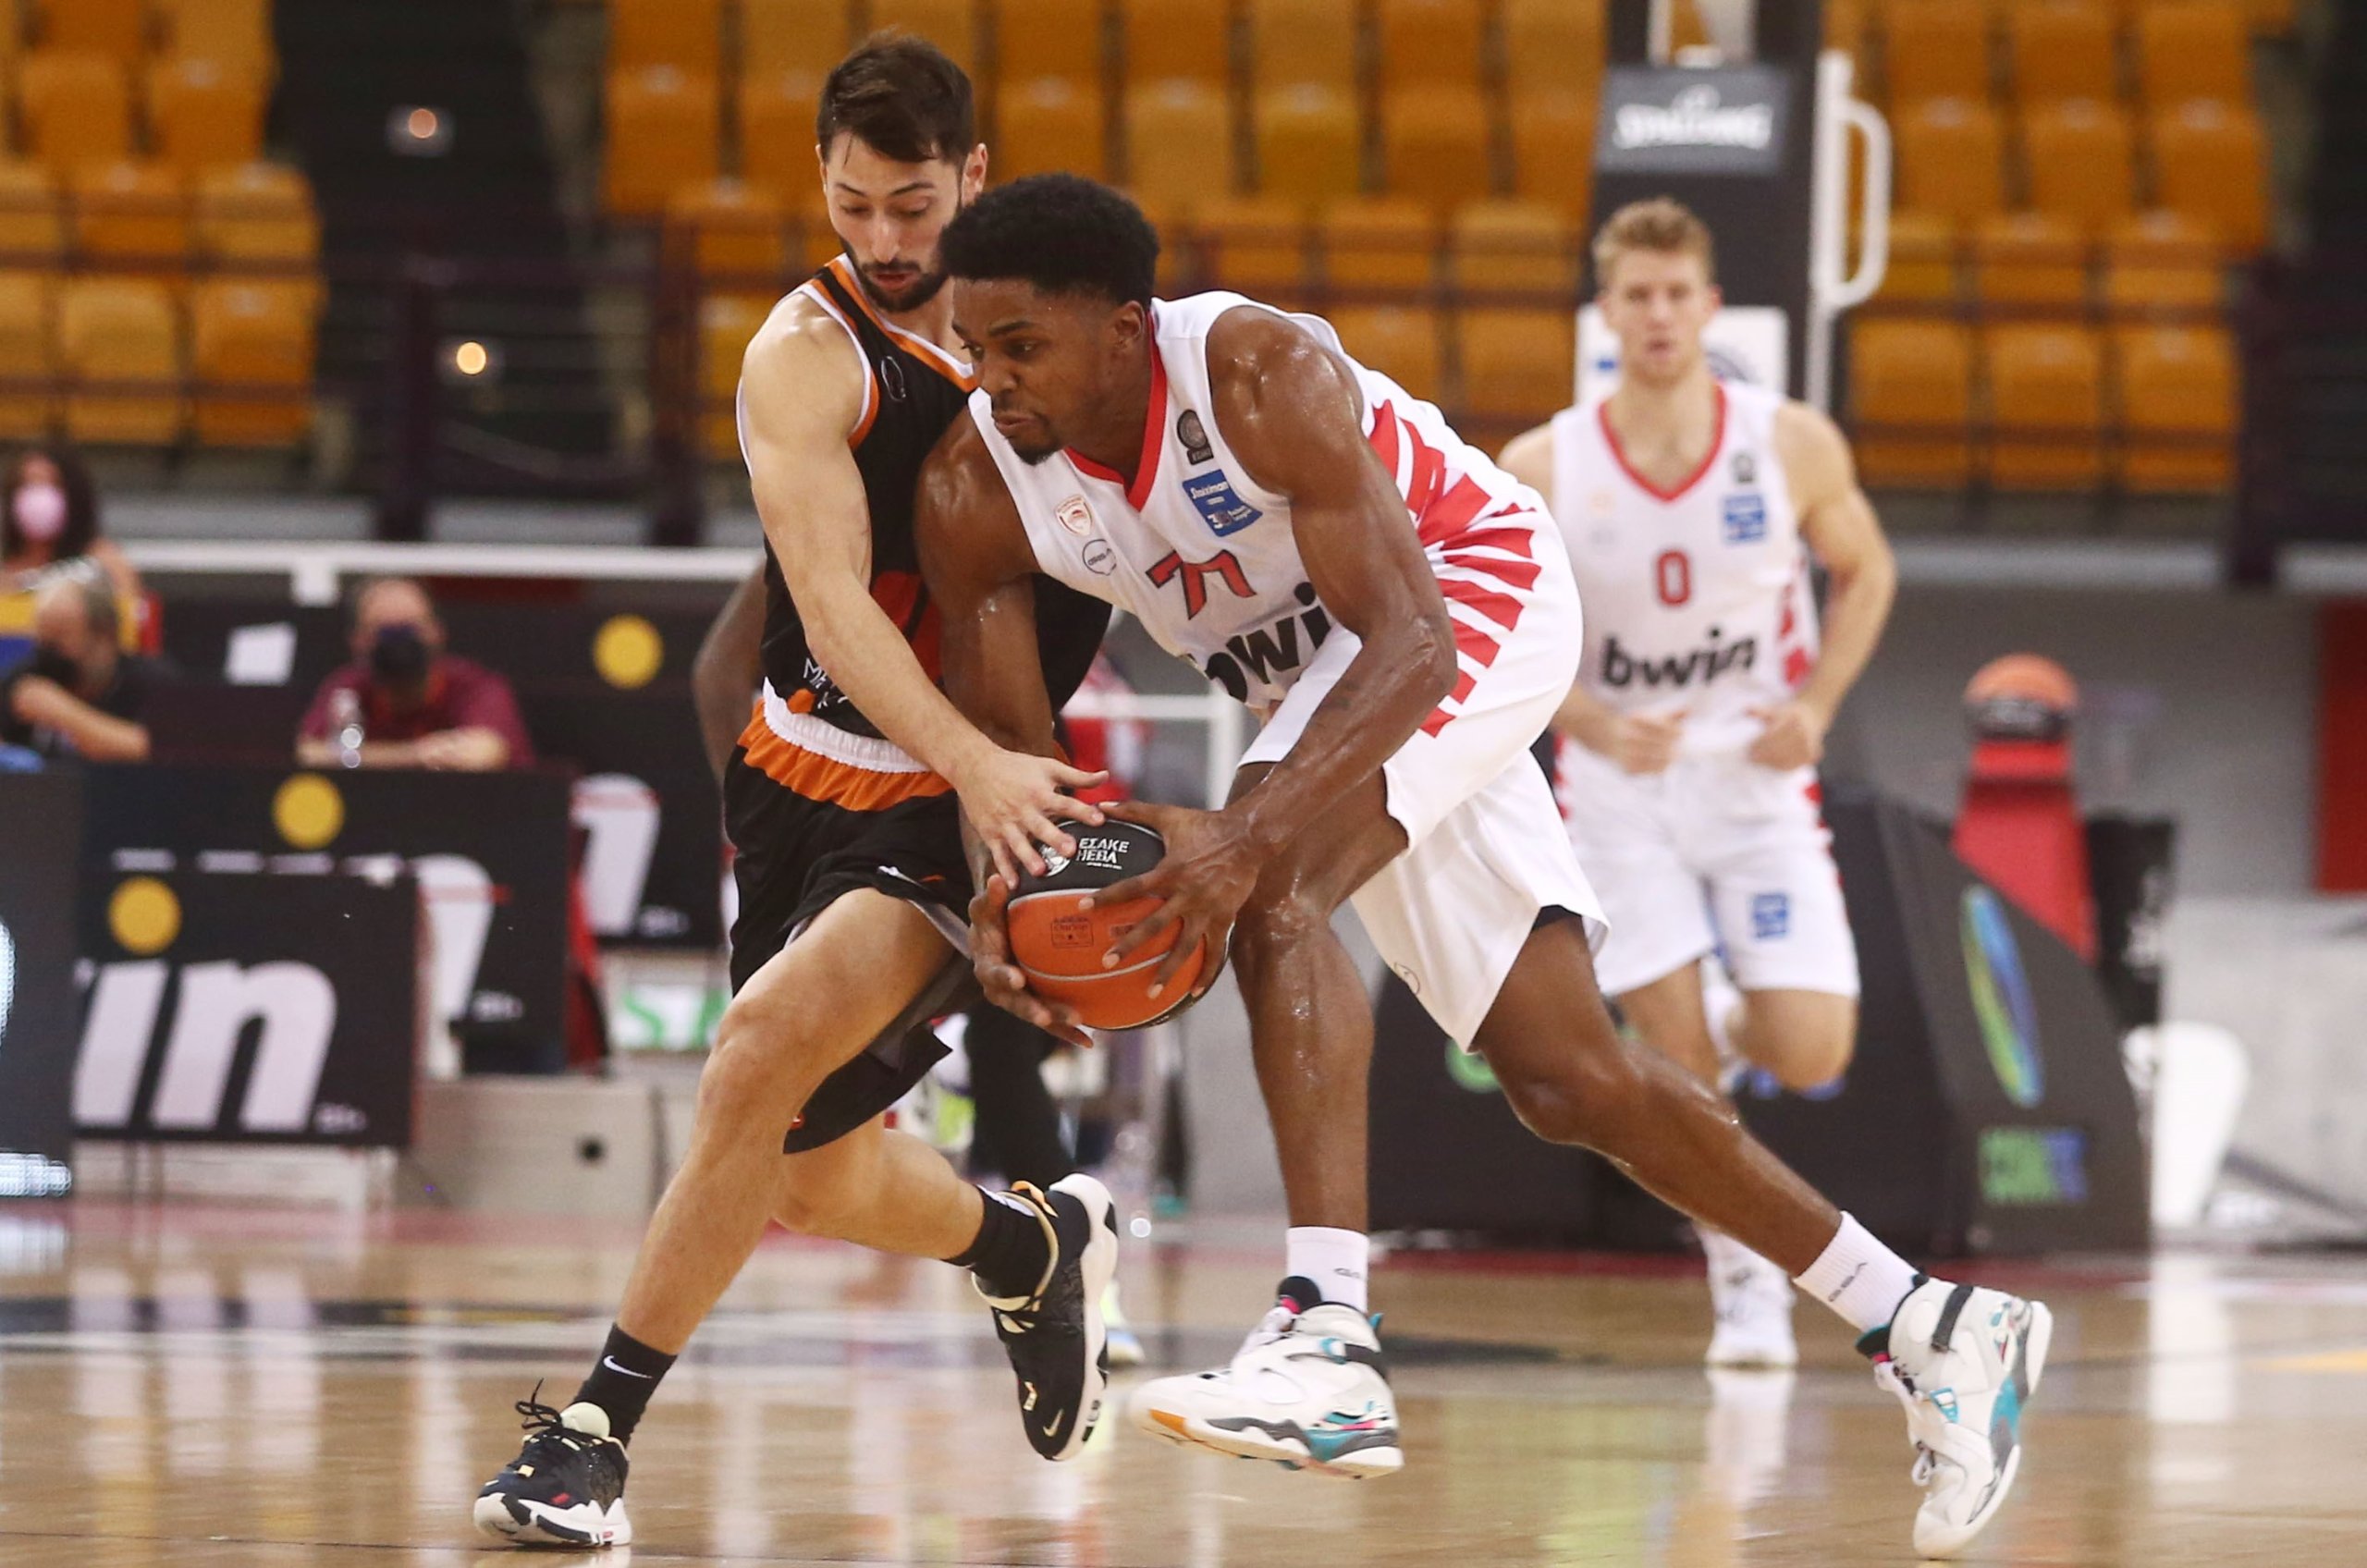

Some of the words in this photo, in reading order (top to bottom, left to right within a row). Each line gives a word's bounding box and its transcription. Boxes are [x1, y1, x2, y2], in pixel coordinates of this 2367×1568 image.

[1655, 549, 1691, 607] 0
[1601, 627, 1756, 686] bwin
[72, 876, 337, 1133] in
